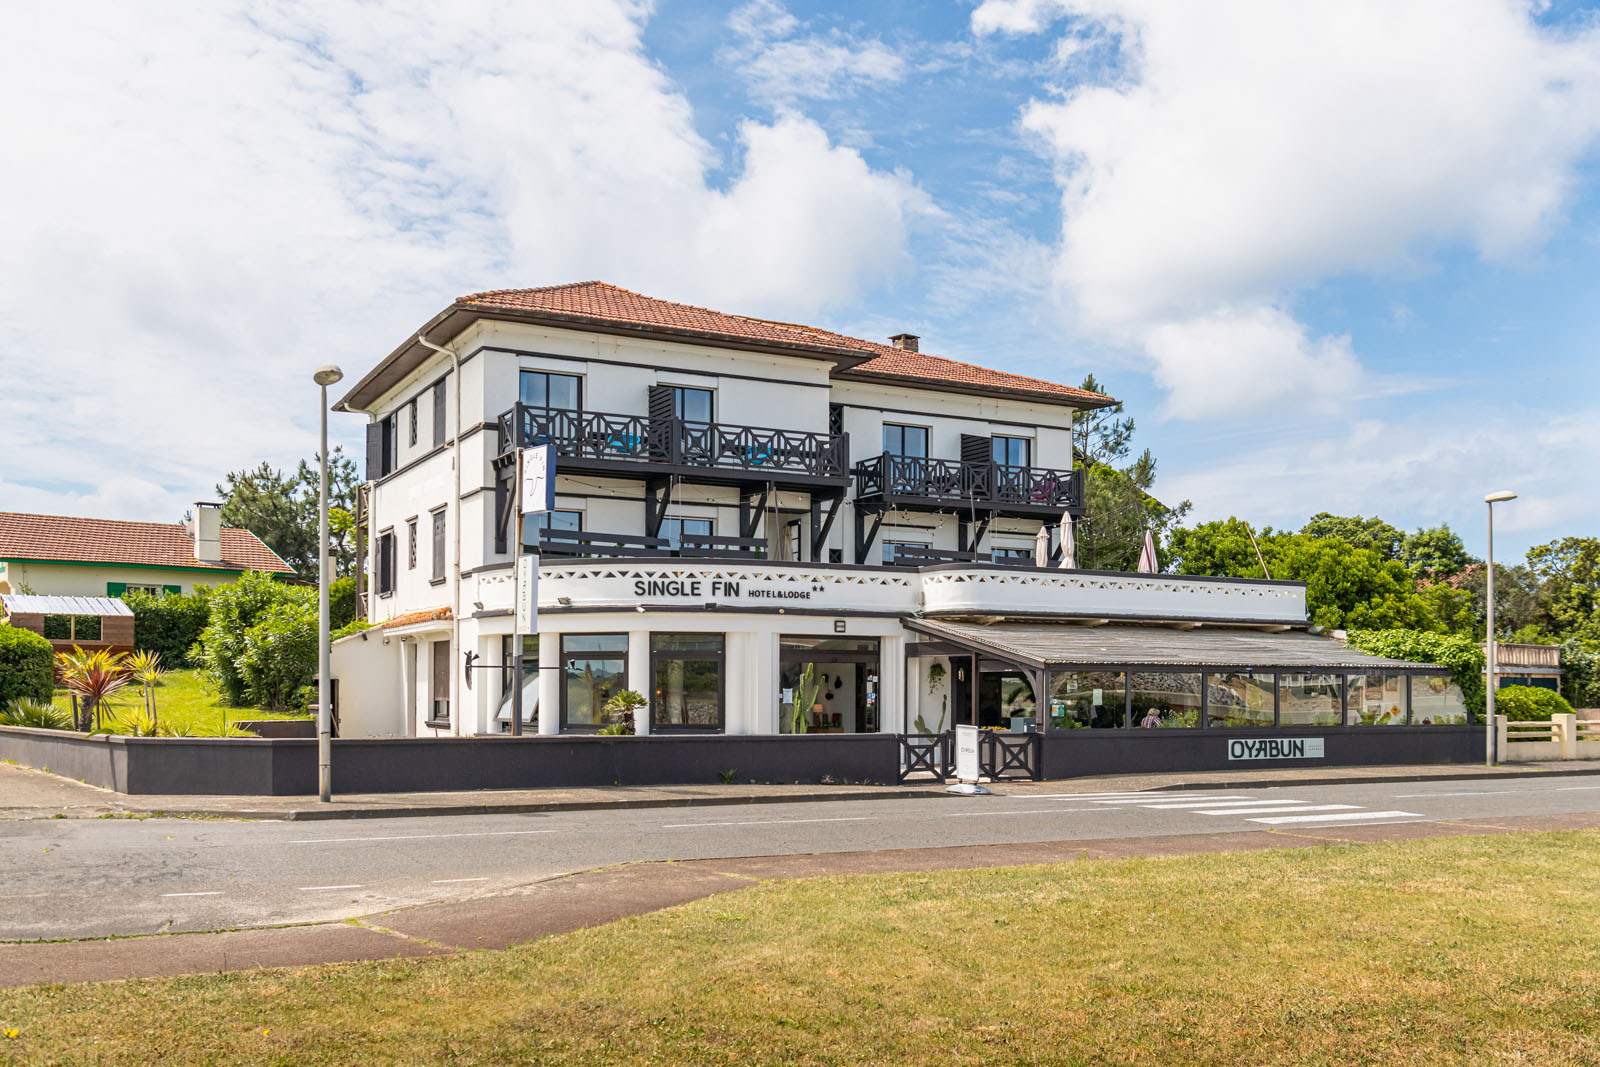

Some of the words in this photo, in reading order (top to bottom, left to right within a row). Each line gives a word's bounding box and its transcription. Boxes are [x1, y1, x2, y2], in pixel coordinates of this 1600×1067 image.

[634, 580, 702, 597] SINGLE
[711, 581, 740, 598] FIN
[1230, 739, 1305, 759] OYABUN
